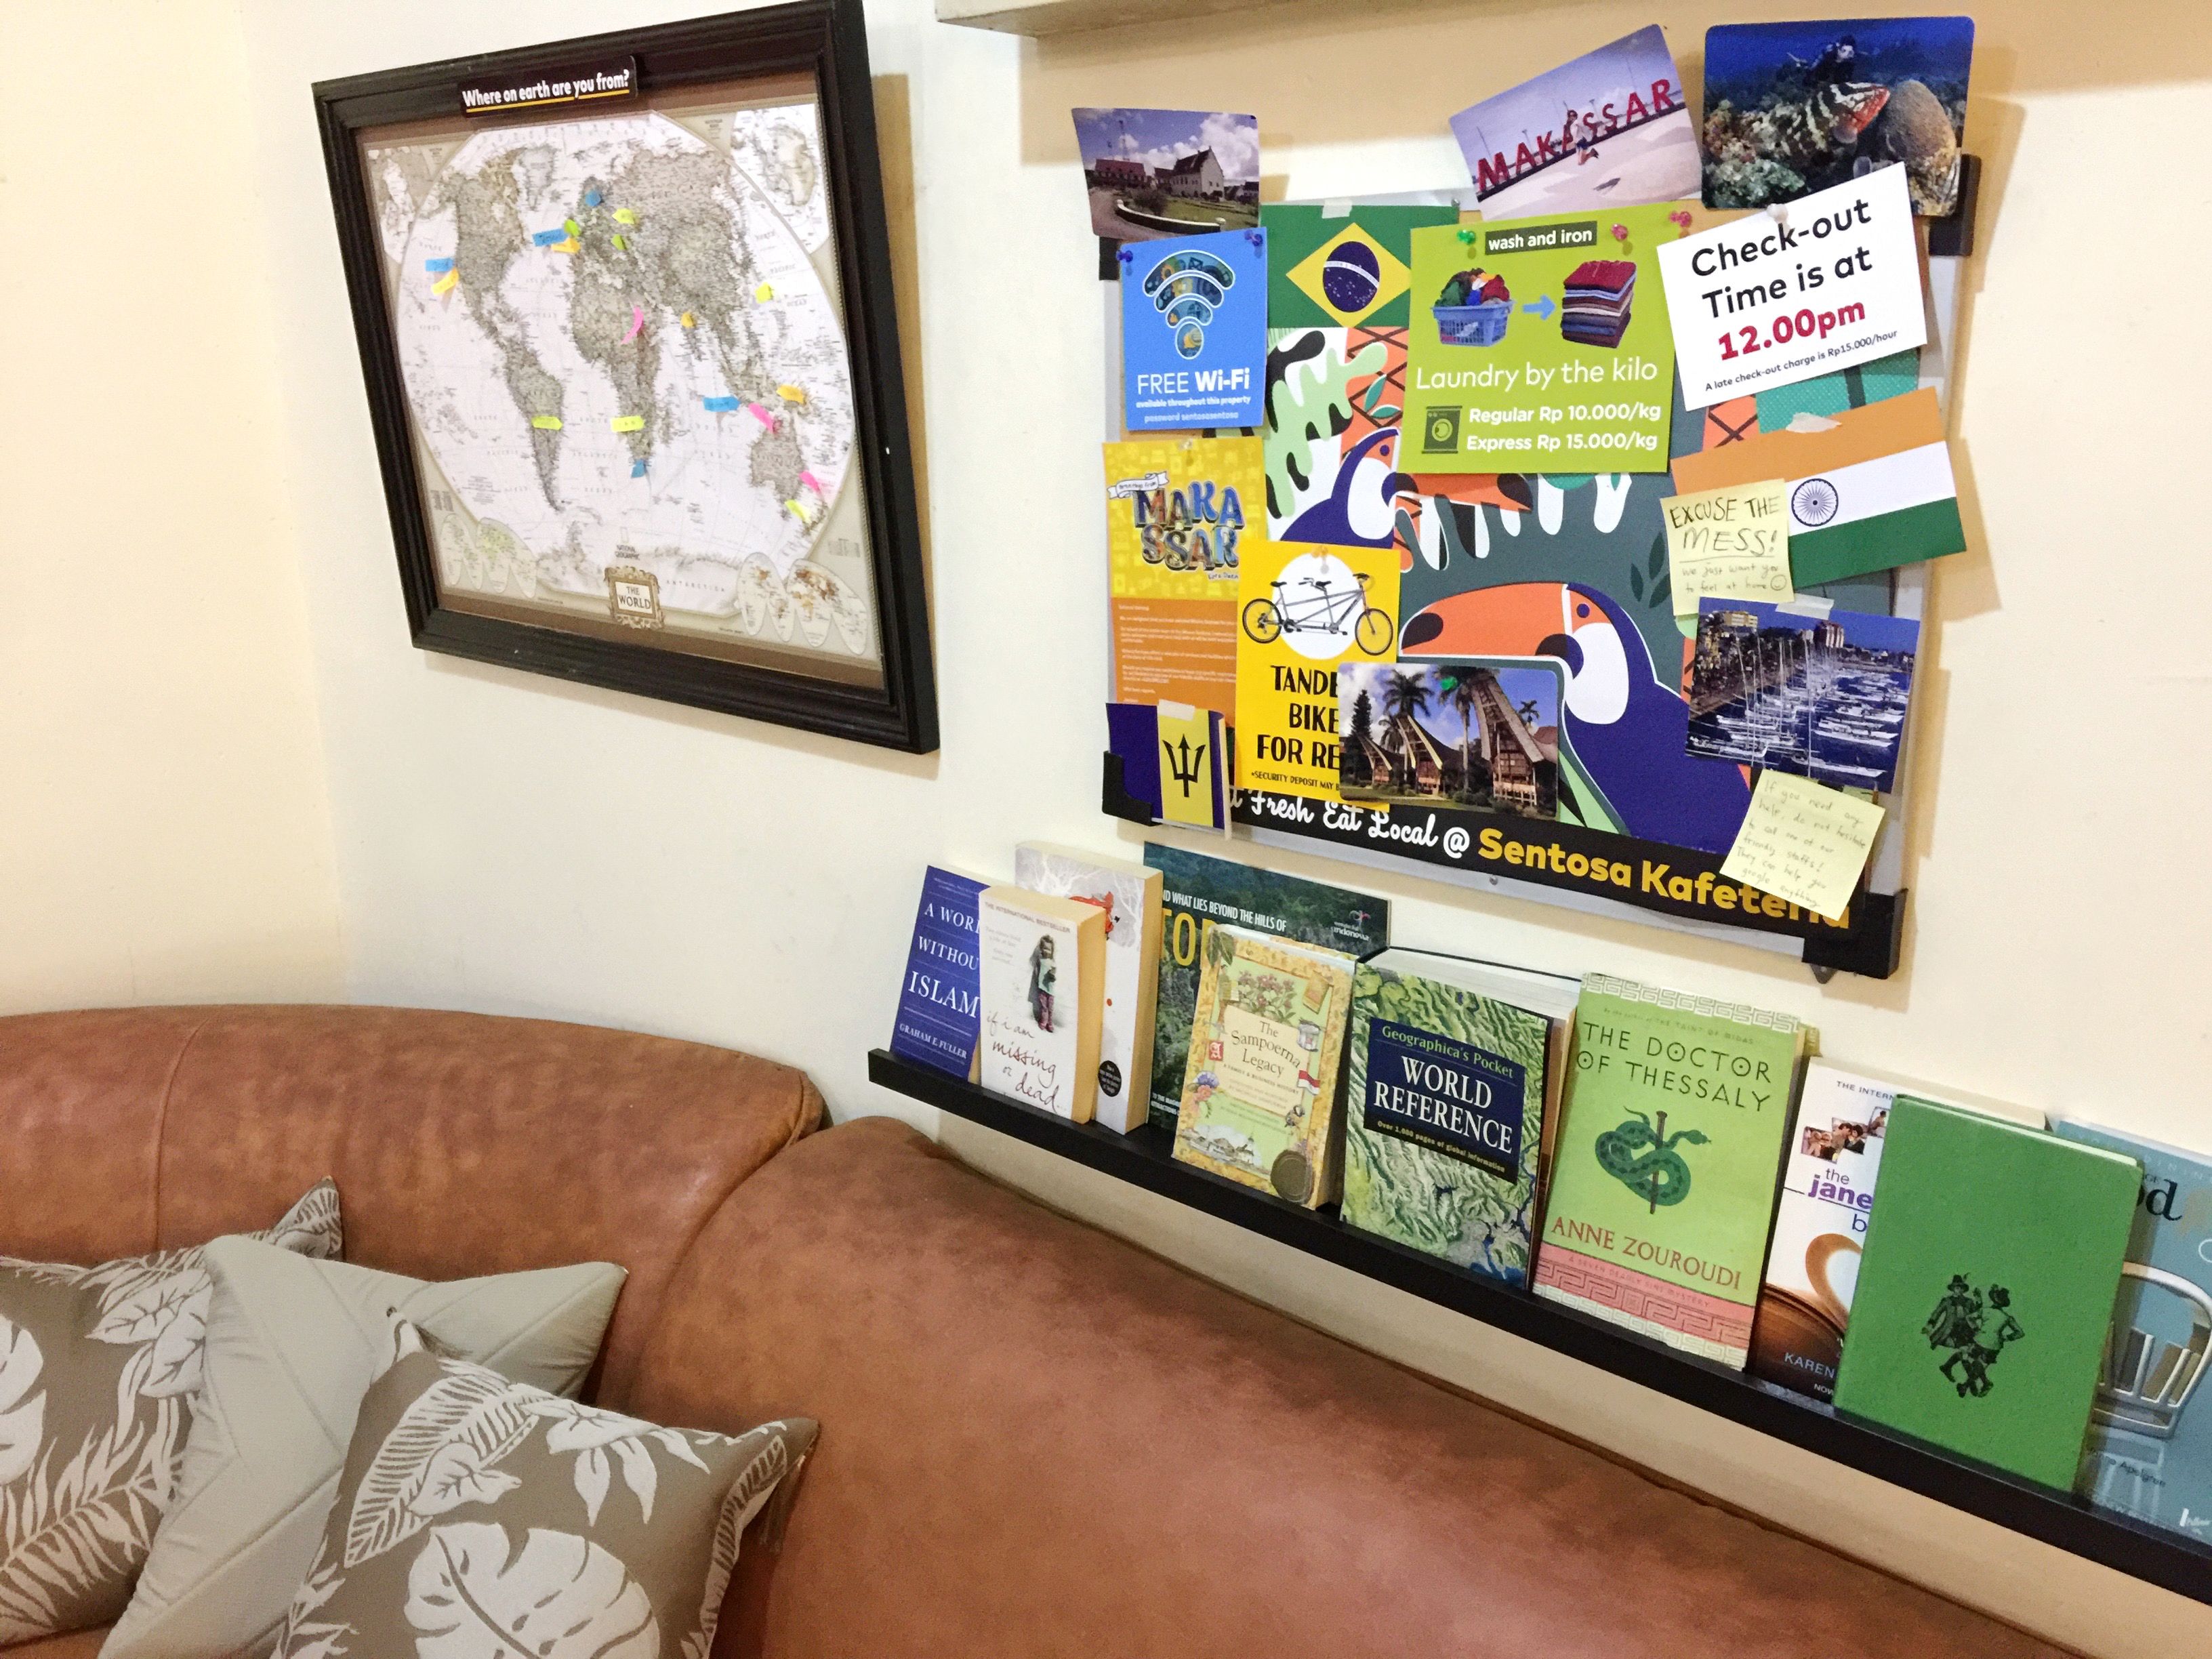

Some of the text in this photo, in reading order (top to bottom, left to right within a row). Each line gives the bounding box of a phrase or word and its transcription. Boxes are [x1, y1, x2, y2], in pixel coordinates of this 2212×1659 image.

[462, 69, 630, 106] Where on earth are you from?
[1477, 79, 1675, 192] MAKASSAR
[1488, 228, 1592, 251] wash and iron
[1692, 199, 1871, 276] Check-out
[1702, 247, 1872, 318] Time is at
[1718, 302, 1865, 361] 12.00pm
[1416, 356, 1657, 392] Laundry by the kilo
[1705, 383, 1712, 391] A
[1715, 378, 1732, 389] late
[1735, 365, 1781, 384] check-out
[1784, 354, 1816, 369] charge
[1828, 330, 1898, 356] Rp15.000/hour
[1138, 367, 1250, 395] FREE Wi-Fi
[1221, 396, 1251, 405] property
[1469, 403, 1660, 425] Regular Rp 10.000/kg
[1467, 431, 1657, 452] Express Rp 15.000/kg
[1132, 480, 1245, 531] MAKA
[1670, 496, 1780, 528] EXCUSE THE
[1142, 524, 1239, 571] SSAR
[1683, 527, 1778, 557] MESS!
[618, 595, 651, 609] WORLD
[626, 586, 640, 595] THE
[1290, 703, 1338, 734] BIKE
[1257, 734, 1303, 765] FOR
[1290, 775, 1318, 787] DEPOSIT
[1320, 781, 1334, 790] MAY
[1765, 779, 1864, 828] If you need any
[1248, 789, 1315, 823] Fresh
[1323, 802, 1364, 831] Eat
[1368, 811, 1439, 847] Local
[1443, 827, 1470, 859] @
[1479, 827, 1632, 887] Sentosa
[1793, 813, 1805, 824] do
[1814, 822, 1829, 832] not
[1744, 831, 1776, 857] friendly
[1737, 846, 1756, 865] They
[1763, 861, 1776, 870] can
[1784, 864, 1801, 881] help
[1742, 868, 1821, 908] google anything
[924, 903, 934, 917] A
[1172, 890, 1286, 932] WHAT LIES BEYOND THE HILLS OF
[908, 970, 980, 1019] ISLAM
[899, 1023, 931, 1043] GRAHAM
[938, 1040, 967, 1059] FULLER
[987, 1010, 998, 1036] if
[1013, 1026, 1035, 1039] am
[1259, 1021, 1279, 1038] The
[992, 1041, 1056, 1088] missing
[1231, 1030, 1300, 1068] Sampoerna
[1242, 1048, 1284, 1078] Legacy
[1382, 1025, 1513, 1078] Geographica's Pocket
[1583, 1021, 1631, 1050] THE
[1647, 1037, 1771, 1083] DOCTOR
[1401, 1056, 1492, 1109] WORLD
[1576, 1050, 1770, 1111] OF THESSALY
[1837, 1080, 1855, 1091] THE
[1374, 1081, 1513, 1154] REFERENCE
[1415, 1132, 1435, 1145] pages
[1446, 1143, 1467, 1157] global
[1808, 1174, 1872, 1210] jane
[1826, 1168, 1849, 1185] the
[1551, 1216, 1742, 1290] ANNE ZOUROUDI
[1784, 1352, 1835, 1378] KAREN
